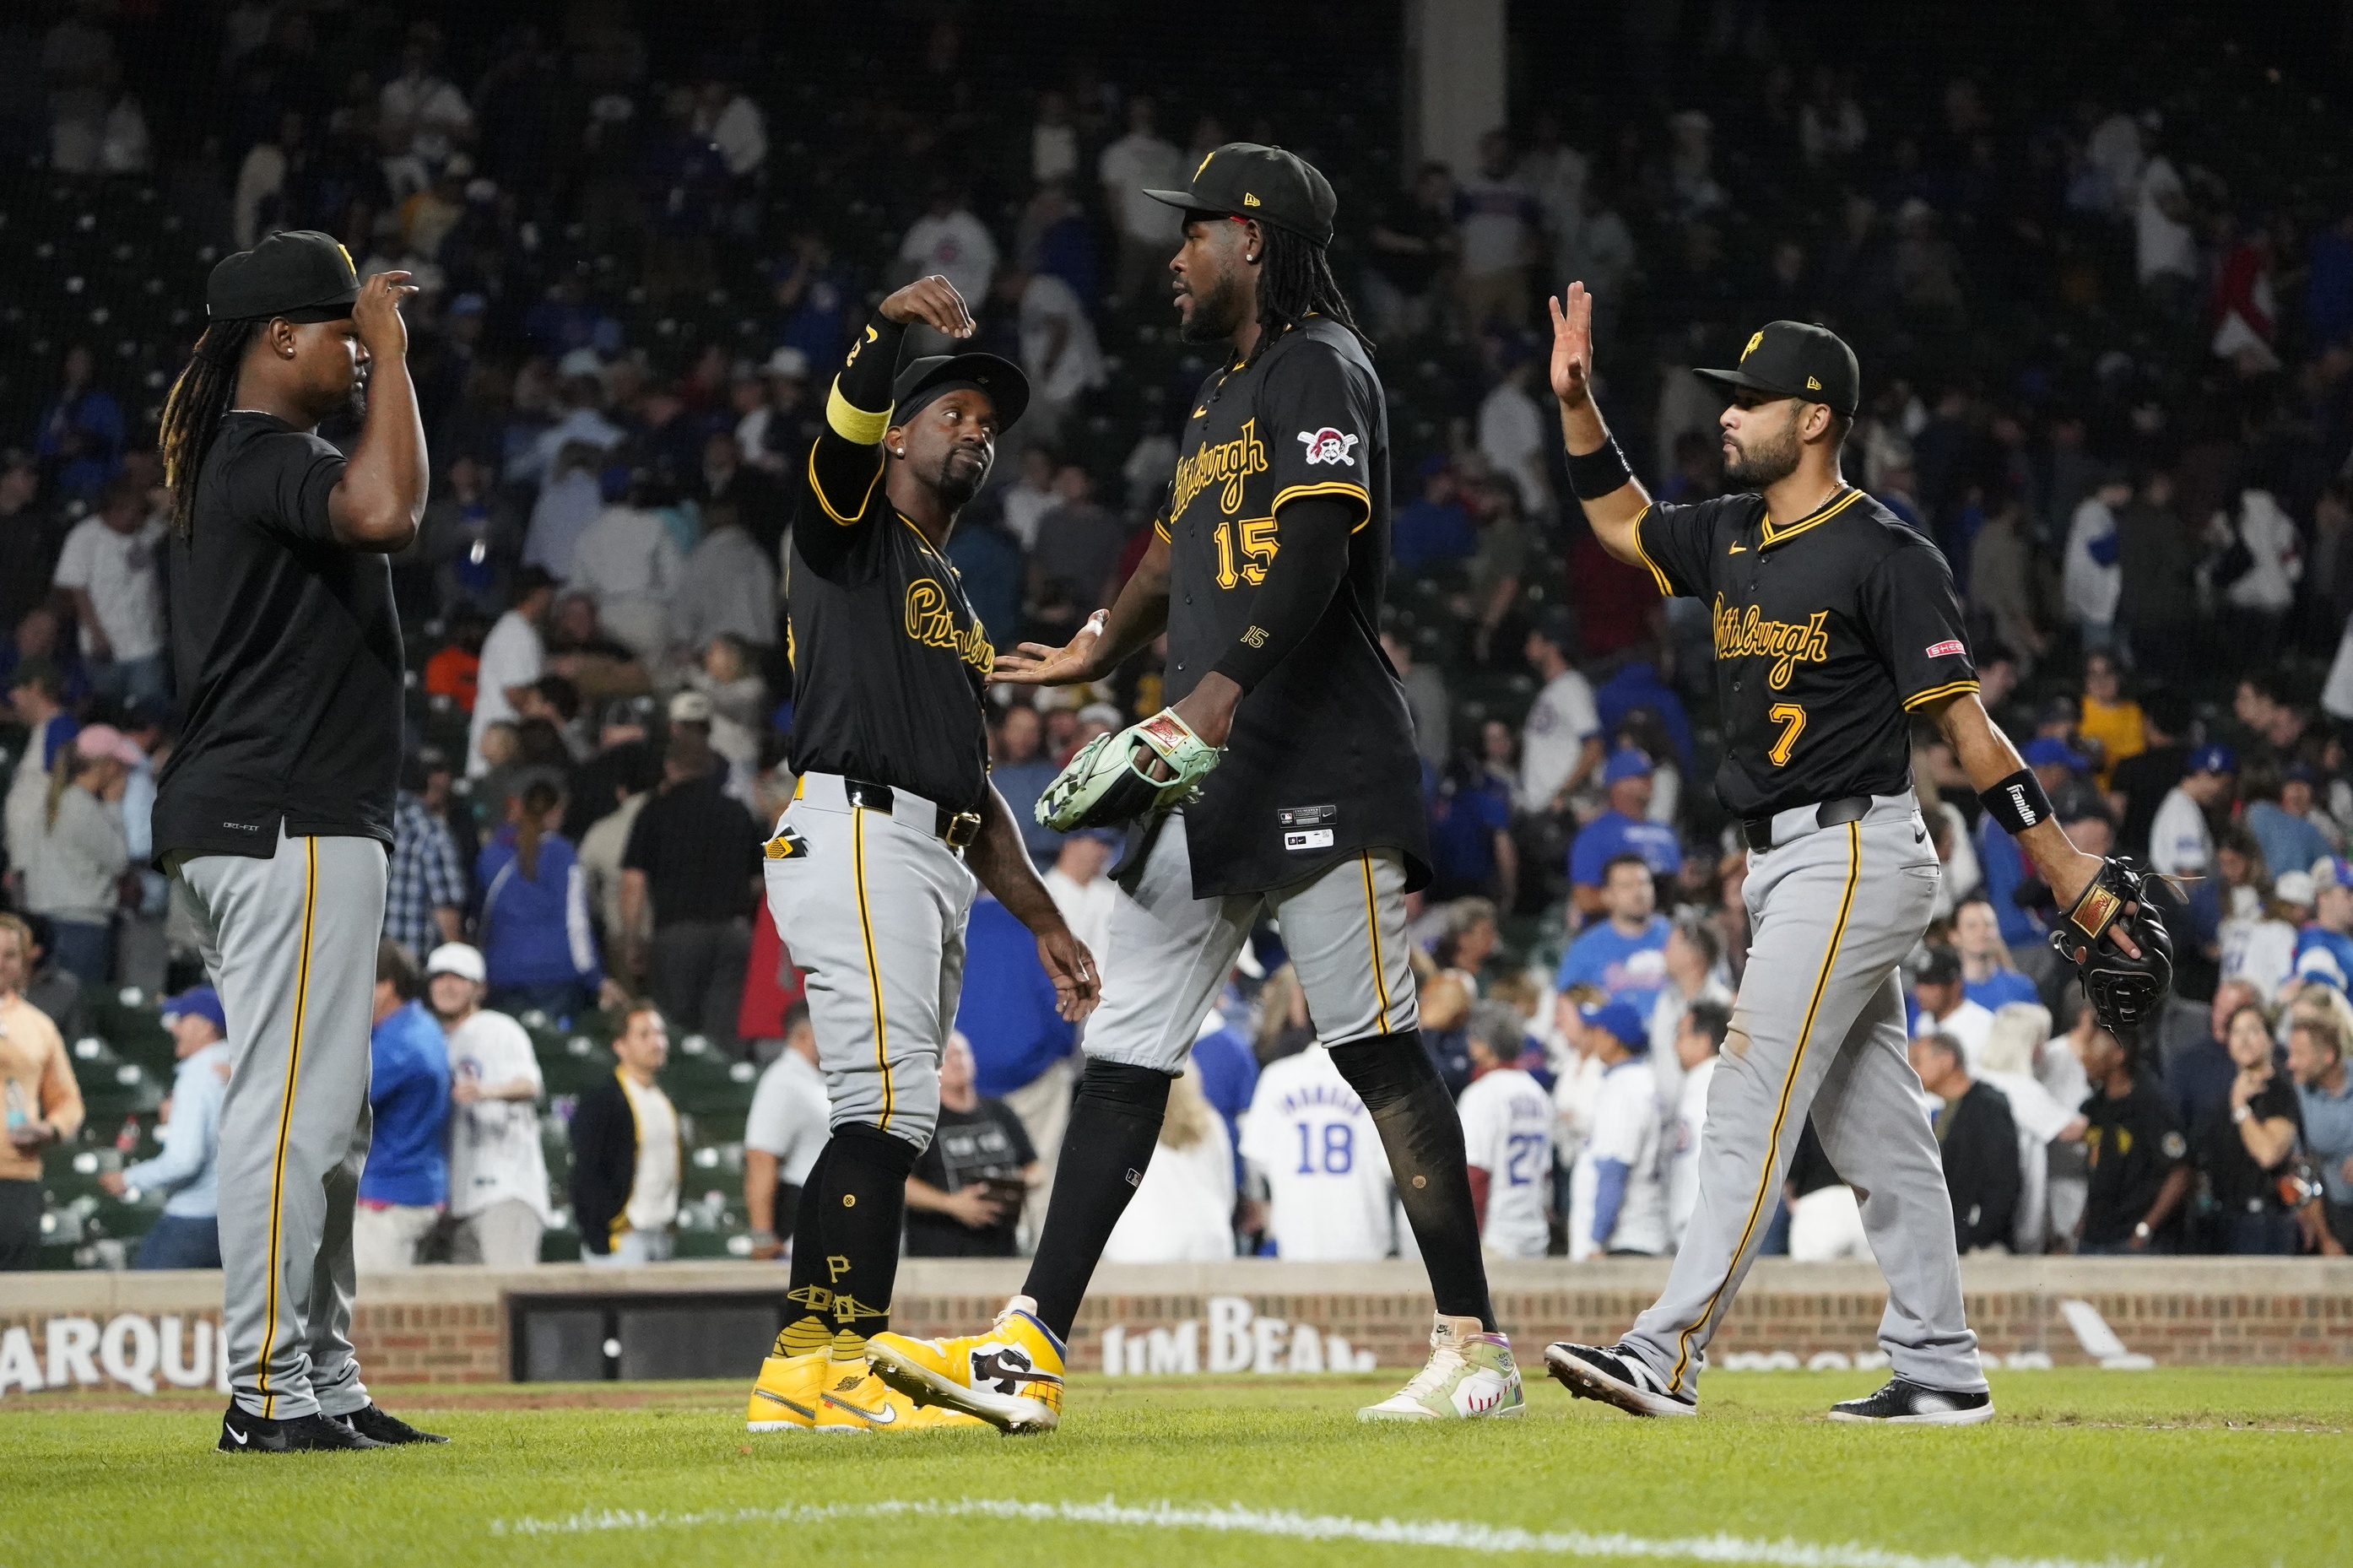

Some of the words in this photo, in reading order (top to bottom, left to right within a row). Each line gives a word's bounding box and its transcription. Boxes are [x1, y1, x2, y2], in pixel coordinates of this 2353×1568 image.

[1214, 516, 1281, 589] 15
[1240, 625, 1269, 648] 15
[1768, 703, 1807, 767] 7
[223, 822, 260, 831] DRI-FIT
[1296, 1122, 1354, 1175] 18
[826, 1254, 852, 1284] P
